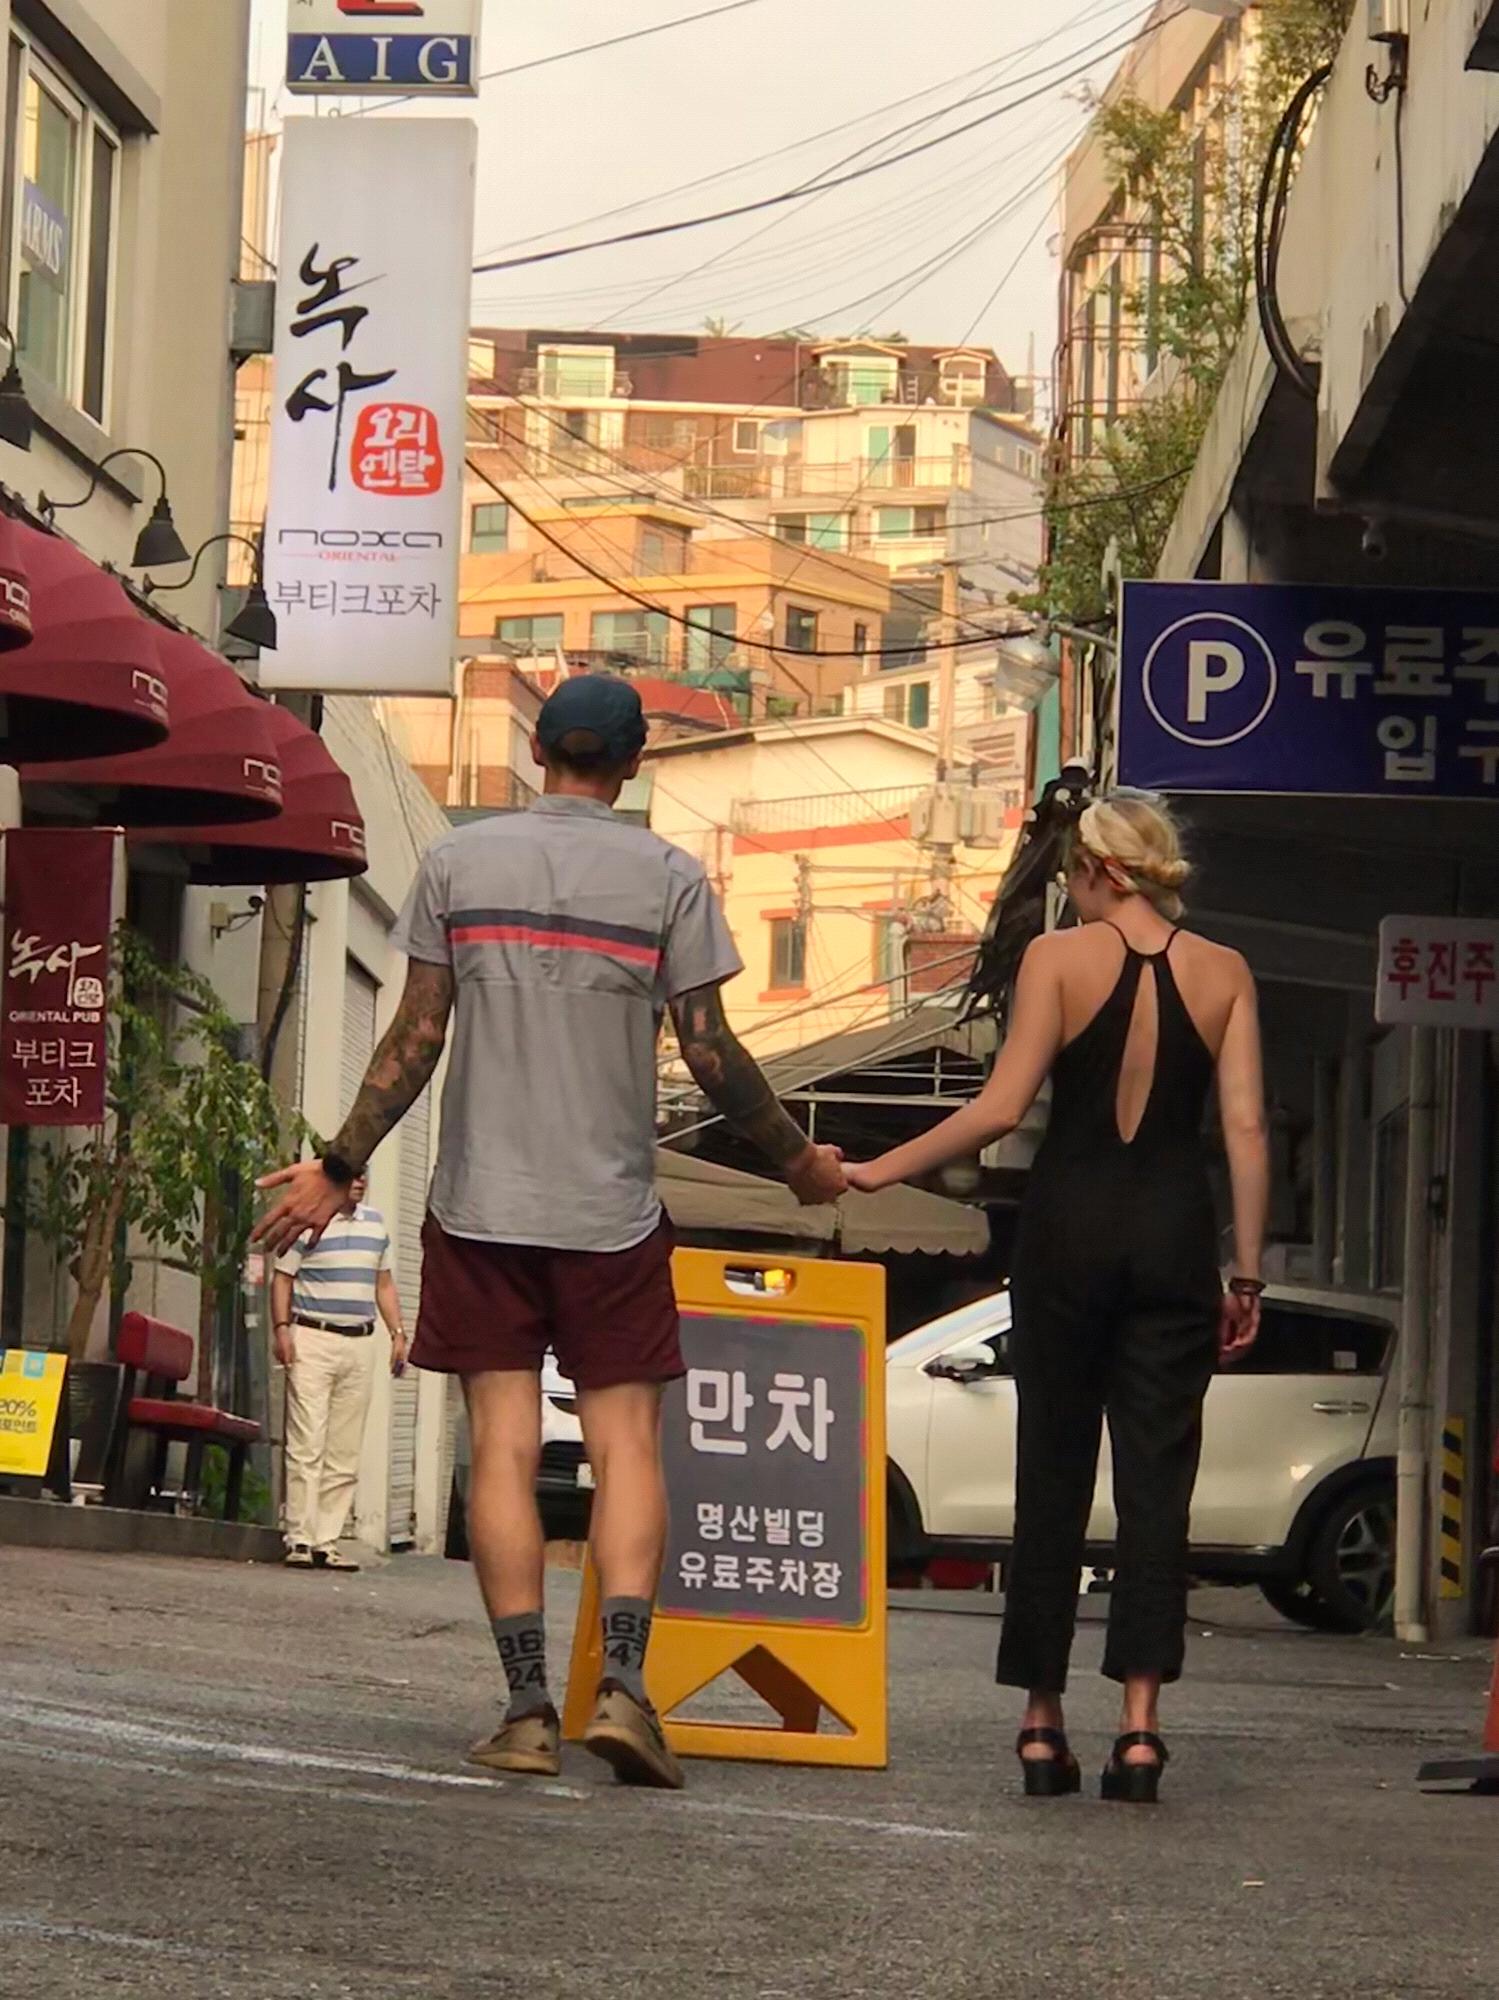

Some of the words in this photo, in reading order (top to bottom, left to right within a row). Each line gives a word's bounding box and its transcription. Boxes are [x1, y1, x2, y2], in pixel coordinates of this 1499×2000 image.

[299, 35, 459, 82] AIG
[286, 242, 397, 492] 녹사
[363, 406, 428, 448] 오리
[279, 529, 442, 548] noxa
[318, 550, 396, 562] ORIENTAL
[272, 580, 442, 620] 부티크포차
[1186, 640, 1245, 723] P
[72, 1011, 101, 1023] PUB
[12, 1038, 97, 1070] 부티크
[25, 1075, 83, 1108] 포차
[686, 1368, 836, 1462] 만차
[697, 1502, 825, 1548] 명산빌딩
[679, 1551, 842, 1599] 유료주차장
